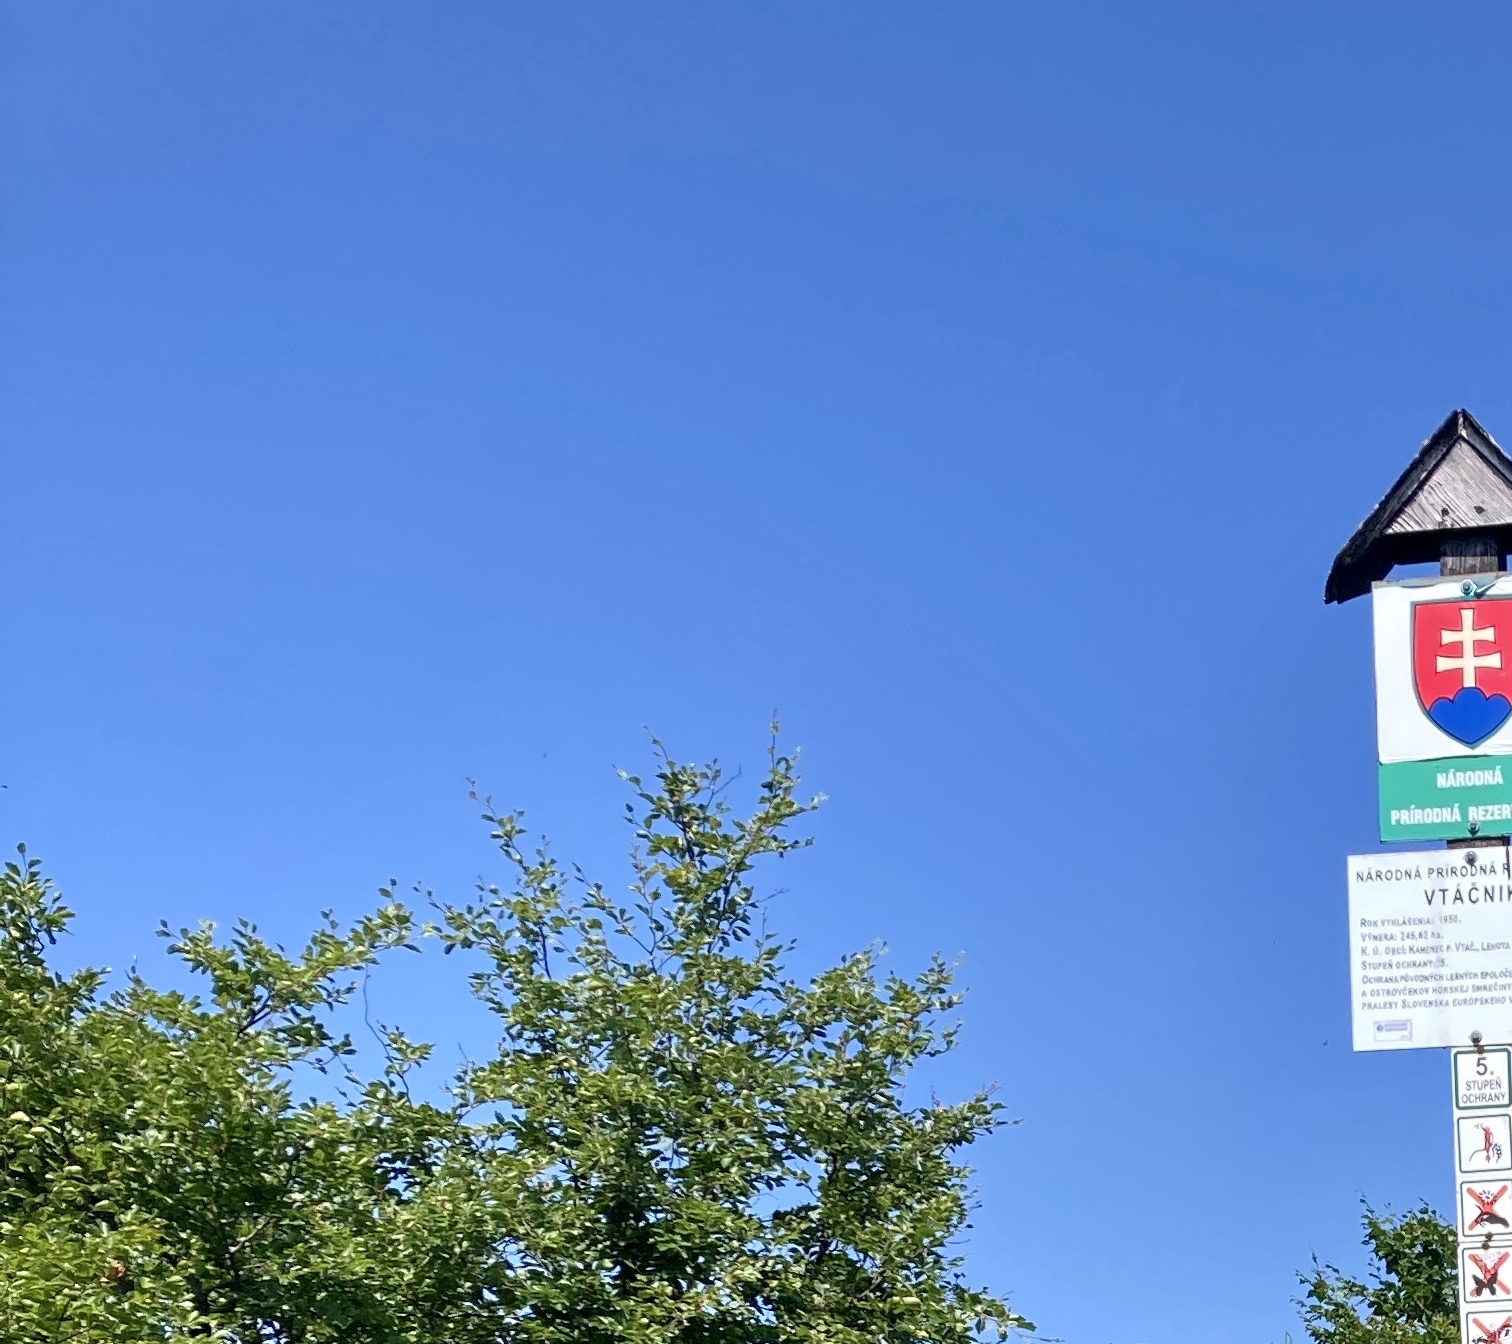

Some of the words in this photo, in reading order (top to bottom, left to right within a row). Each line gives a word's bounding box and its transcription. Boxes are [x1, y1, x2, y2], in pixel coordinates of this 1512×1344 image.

[1436, 765, 1504, 789] NÁRODNÁ
[1390, 804, 1462, 825] PRÍRODNÁ
[1356, 866, 1422, 882] NÁRODNÁ
[1427, 862, 1497, 879] PRÍRODNÁ
[1476, 1056, 1495, 1076] 5.
[1465, 1076, 1502, 1091] STUPEŇ
[1461, 1090, 1507, 1105] OCHRANY
